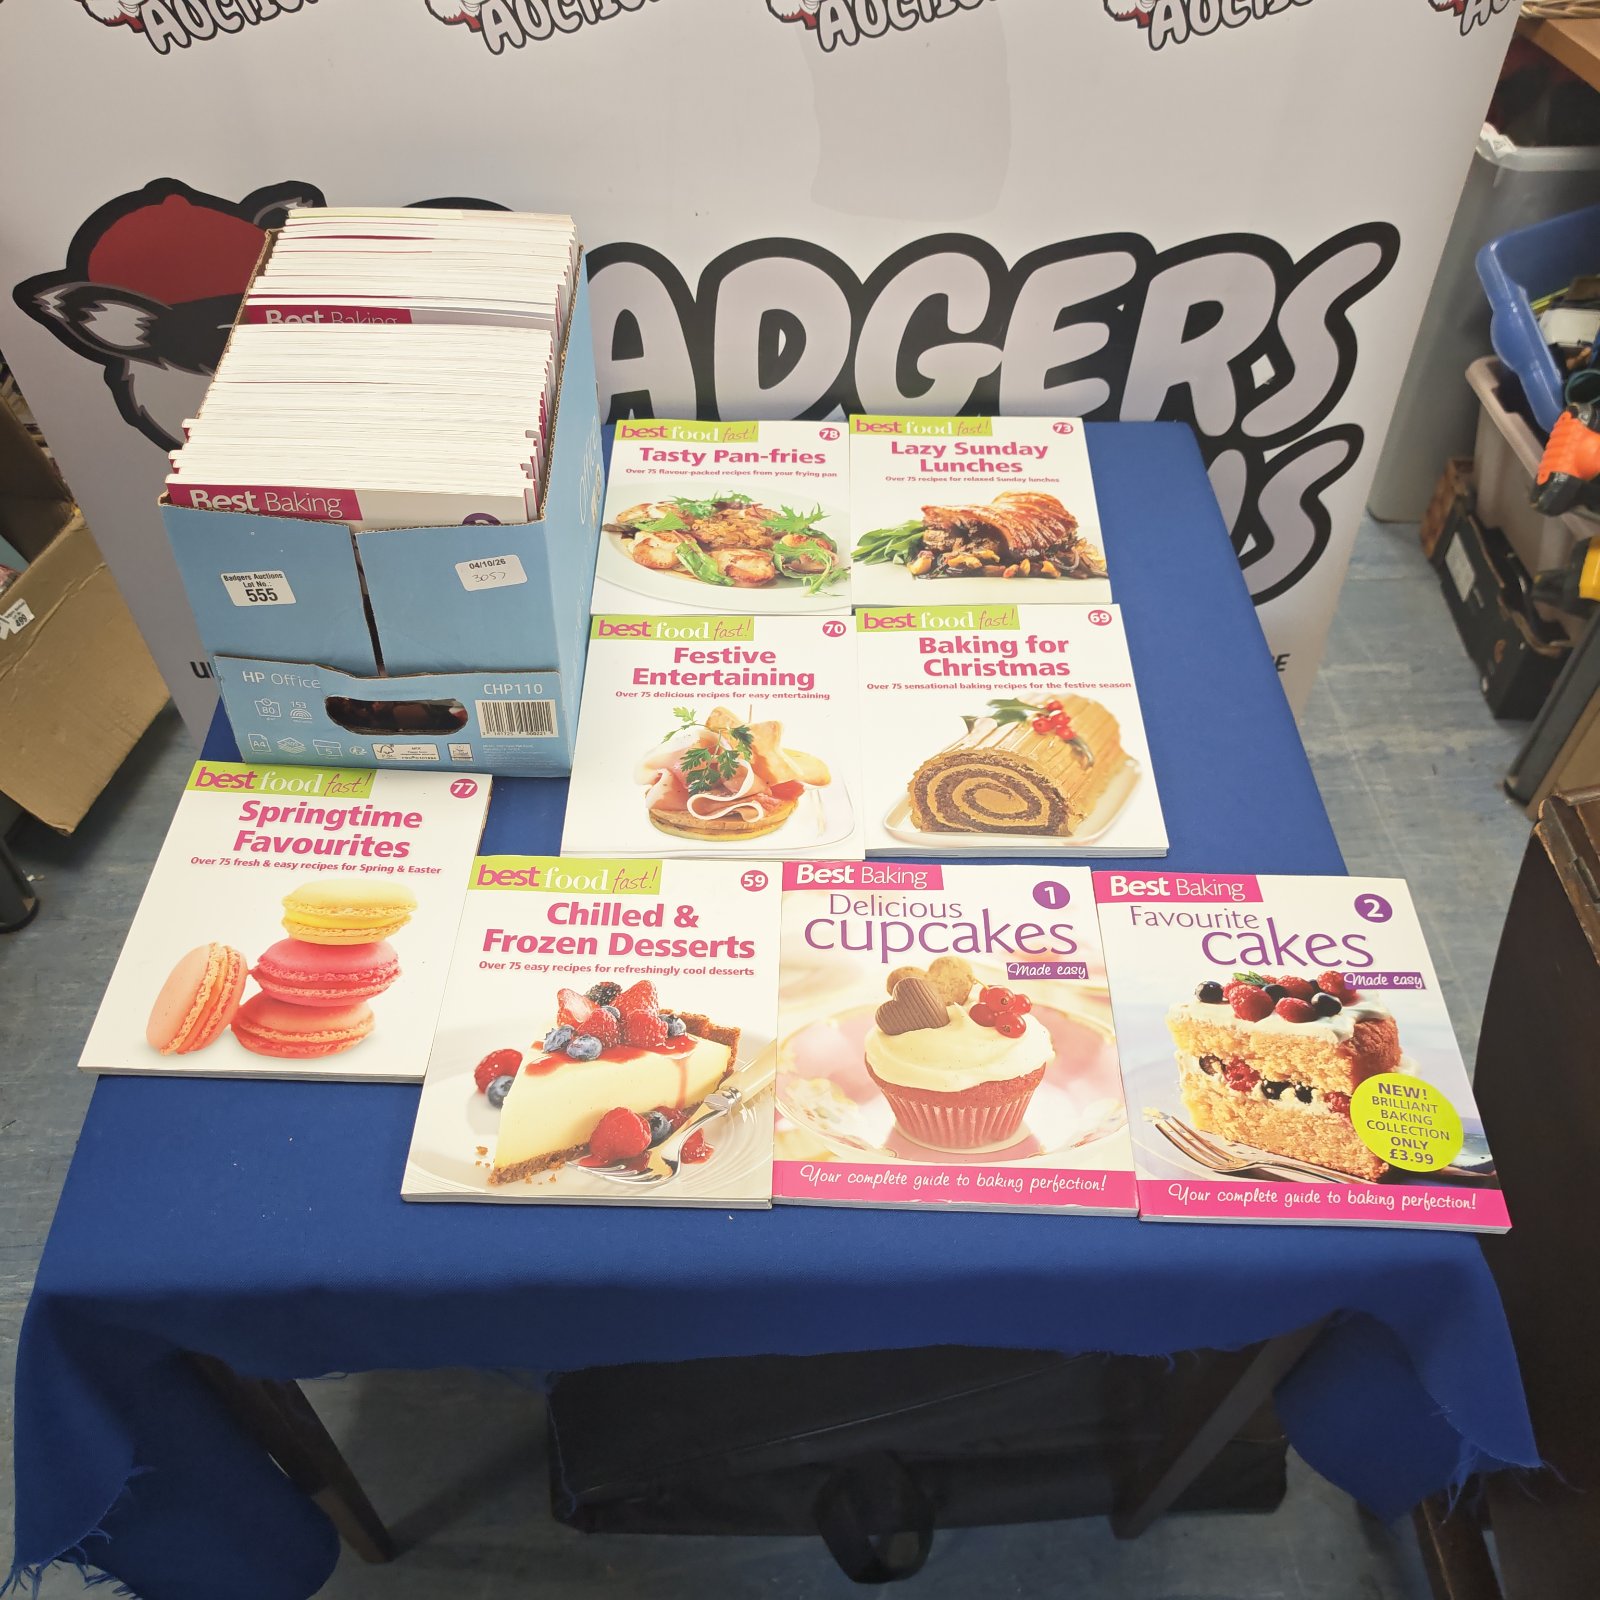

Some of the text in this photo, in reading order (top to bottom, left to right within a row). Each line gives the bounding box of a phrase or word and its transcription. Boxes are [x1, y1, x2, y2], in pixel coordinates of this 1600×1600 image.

[621, 424, 755, 443] best food fast!
[821, 429, 838, 439] 78
[856, 419, 989, 436] best food fast!
[1055, 424, 1072, 433] 73
[640, 448, 825, 466] Tasty Pan-fries
[891, 442, 1048, 459] Lazy Sunday
[920, 459, 1022, 472] Lunches
[190, 489, 342, 518] Best Baking
[469, 559, 506, 569] 04/10/26
[246, 588, 278, 602] 555
[864, 609, 1014, 630] best food fast!
[1090, 612, 1110, 623] 69
[599, 619, 751, 640] best food fast!
[825, 624, 844, 634] 70
[919, 635, 1069, 657] Baking for
[674, 647, 776, 664] Festive
[924, 658, 1070, 676] Christmas
[242, 671, 320, 689] HP Office
[633, 668, 815, 690] Entertaining
[960, 682, 991, 690] baking
[994, 682, 1027, 690] recipes
[484, 684, 543, 694] CHP110
[653, 691, 694, 699] delicious
[772, 692, 830, 700] entertaining
[291, 701, 307, 709] 153
[195, 767, 372, 796] best food fast!
[453, 782, 475, 794] 77
[238, 800, 422, 831] Springtime
[233, 830, 410, 858] Favourites
[191, 856, 442, 875] Over 75 fresh & easy recipes for Spring & Easter
[477, 864, 658, 893] best food fast!
[744, 874, 766, 887] 59
[797, 865, 927, 889] Best Baking
[1045, 886, 1056, 904] 1
[1110, 875, 1245, 901] Best Baking
[547, 902, 699, 928] Chilled &
[830, 894, 962, 918] Delicious
[1363, 899, 1385, 918] 2
[1130, 905, 1260, 928] Favourite
[482, 929, 755, 959] Frozen Desserts
[804, 908, 1078, 963] cupcakes
[1202, 917, 1374, 968] cakes
[479, 960, 754, 976] Over 75 easy recipes for refreshingly cool desserts
[1008, 962, 1086, 978] Made easy
[1344, 972, 1423, 989] Made easy
[1378, 1083, 1427, 1100] NEW!
[1372, 1096, 1437, 1114] BRILLIANT
[1381, 1110, 1432, 1125] BAKING
[1367, 1120, 1450, 1140] COLLECTION
[1391, 1137, 1428, 1150] ONLY
[1390, 1149, 1434, 1164] £3.99
[801, 1165, 1106, 1193] Your complete guide to baking perfection!
[1168, 1184, 1476, 1211] Your complete guide to baking perfection!
